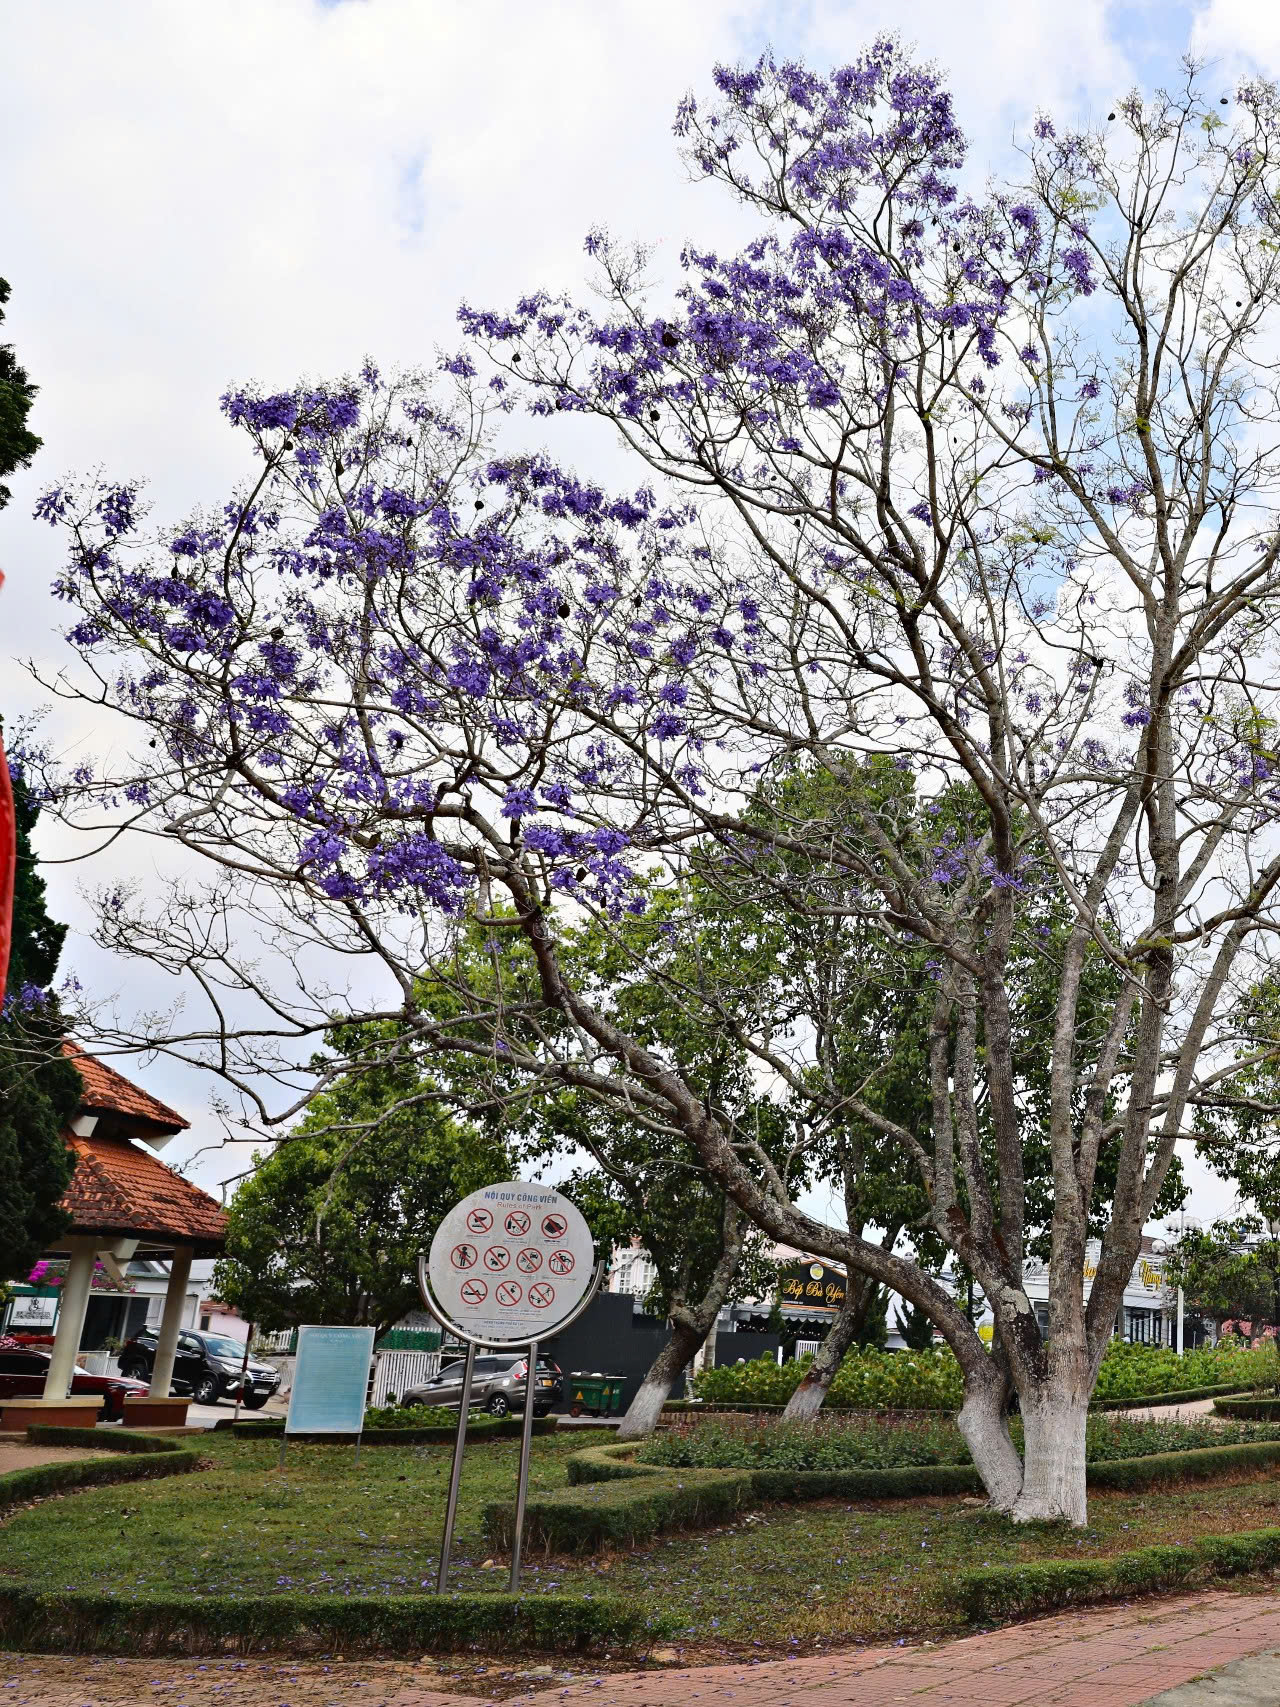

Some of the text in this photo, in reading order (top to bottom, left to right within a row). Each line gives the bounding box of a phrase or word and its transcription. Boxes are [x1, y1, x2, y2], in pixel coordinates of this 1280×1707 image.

[500, 1192, 516, 1201] QUY
[516, 1193, 538, 1203] CÔNG
[539, 1195, 558, 1204] VIÊN
